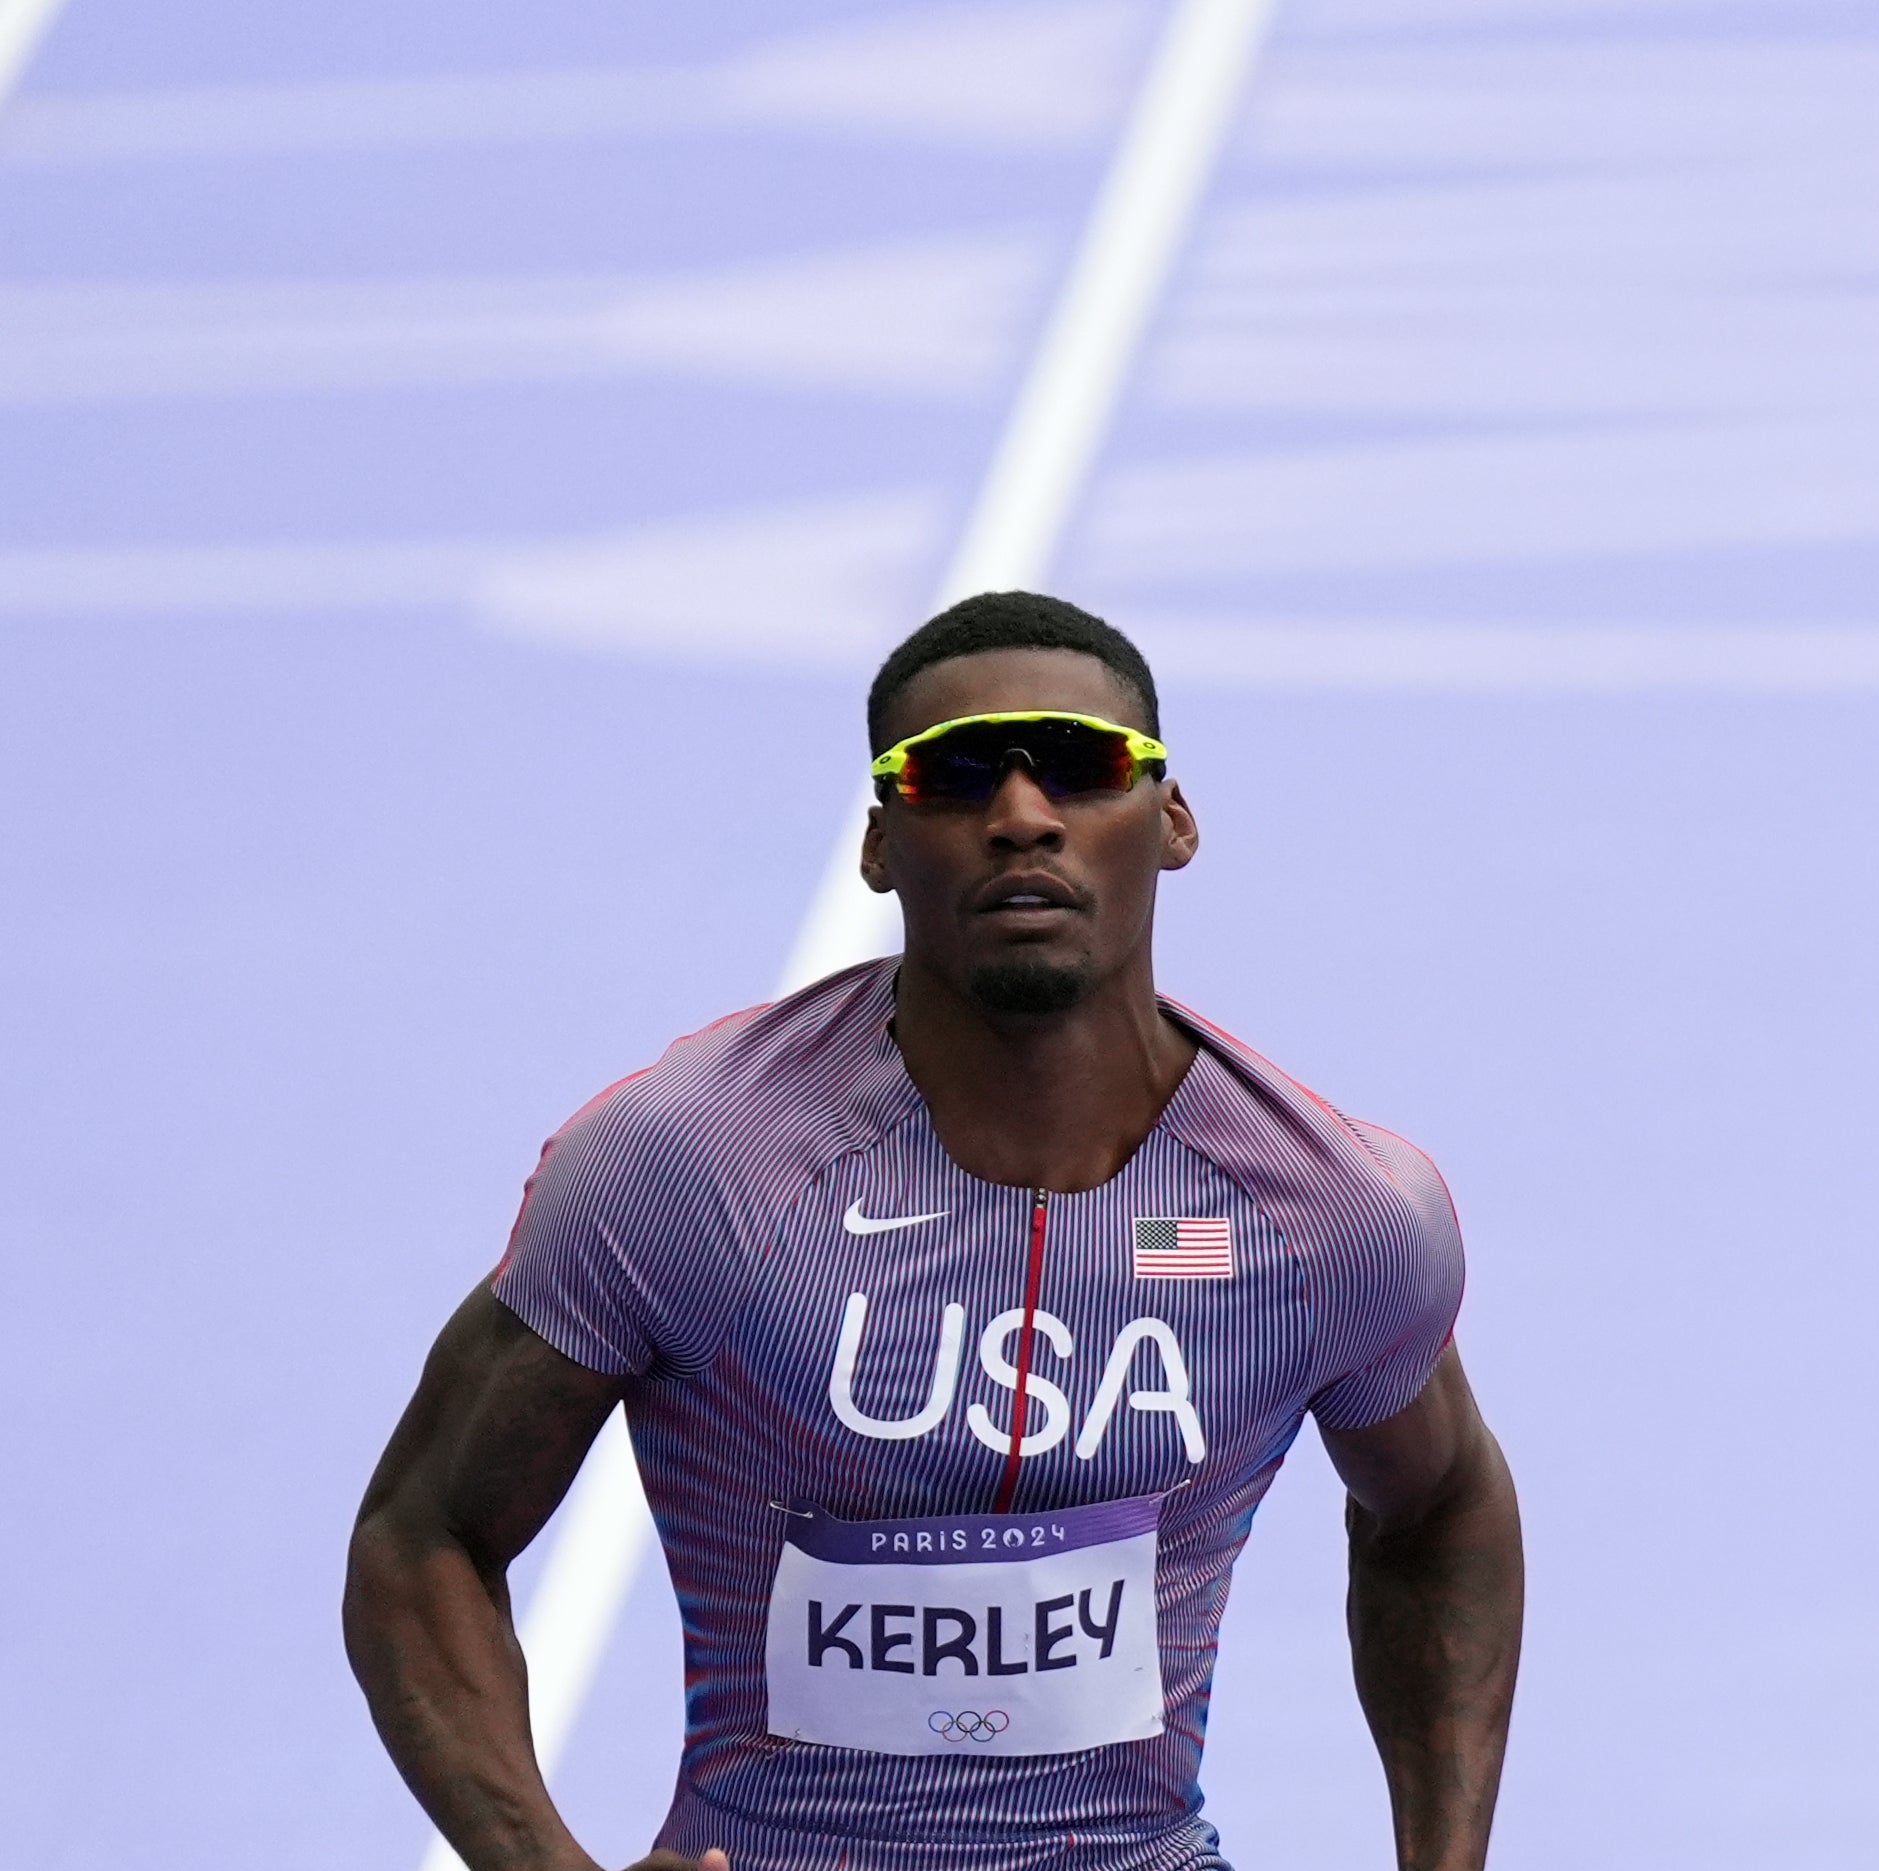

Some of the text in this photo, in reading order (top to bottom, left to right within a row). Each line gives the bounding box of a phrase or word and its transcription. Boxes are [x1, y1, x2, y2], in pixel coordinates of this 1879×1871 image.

[828, 1292, 1206, 1464] USA
[980, 1523, 1066, 1549] 2024
[806, 1578, 1126, 1677] KERLEY
